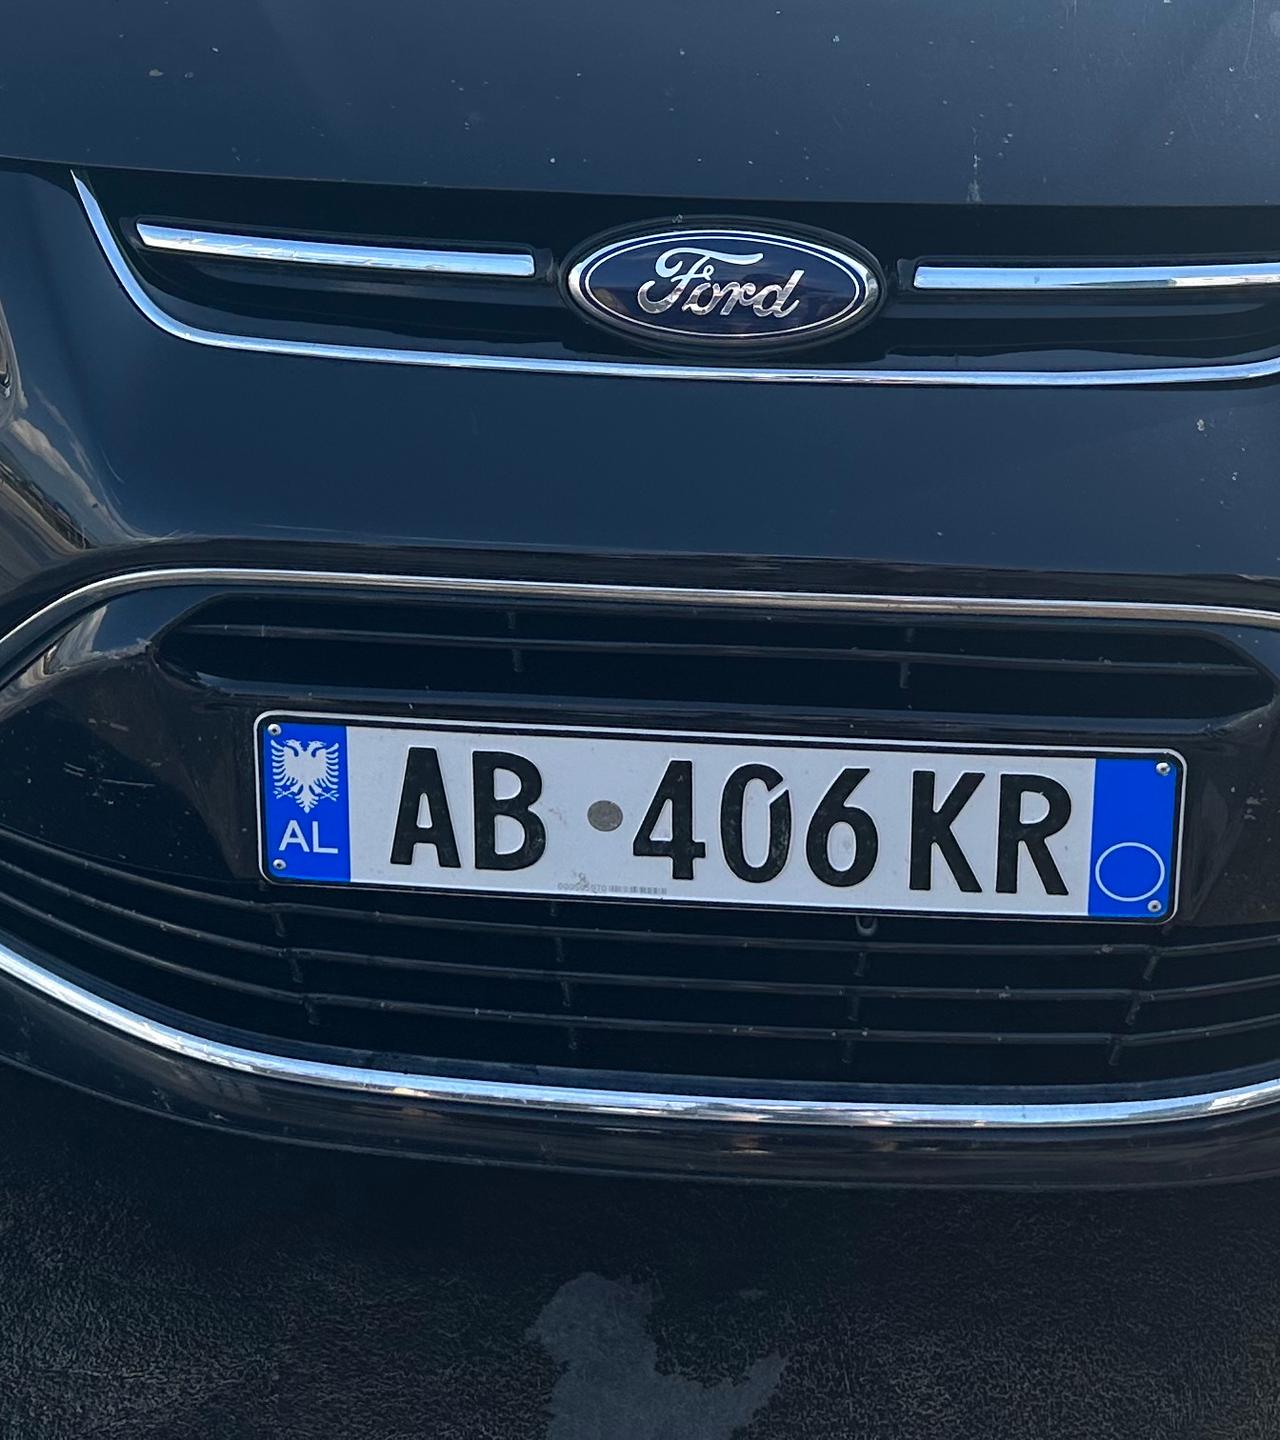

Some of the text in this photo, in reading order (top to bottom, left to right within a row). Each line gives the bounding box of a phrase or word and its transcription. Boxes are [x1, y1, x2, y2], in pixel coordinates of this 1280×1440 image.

[637, 247, 805, 318] Ford
[278, 819, 339, 854] AL
[389, 746, 547, 871] AB
